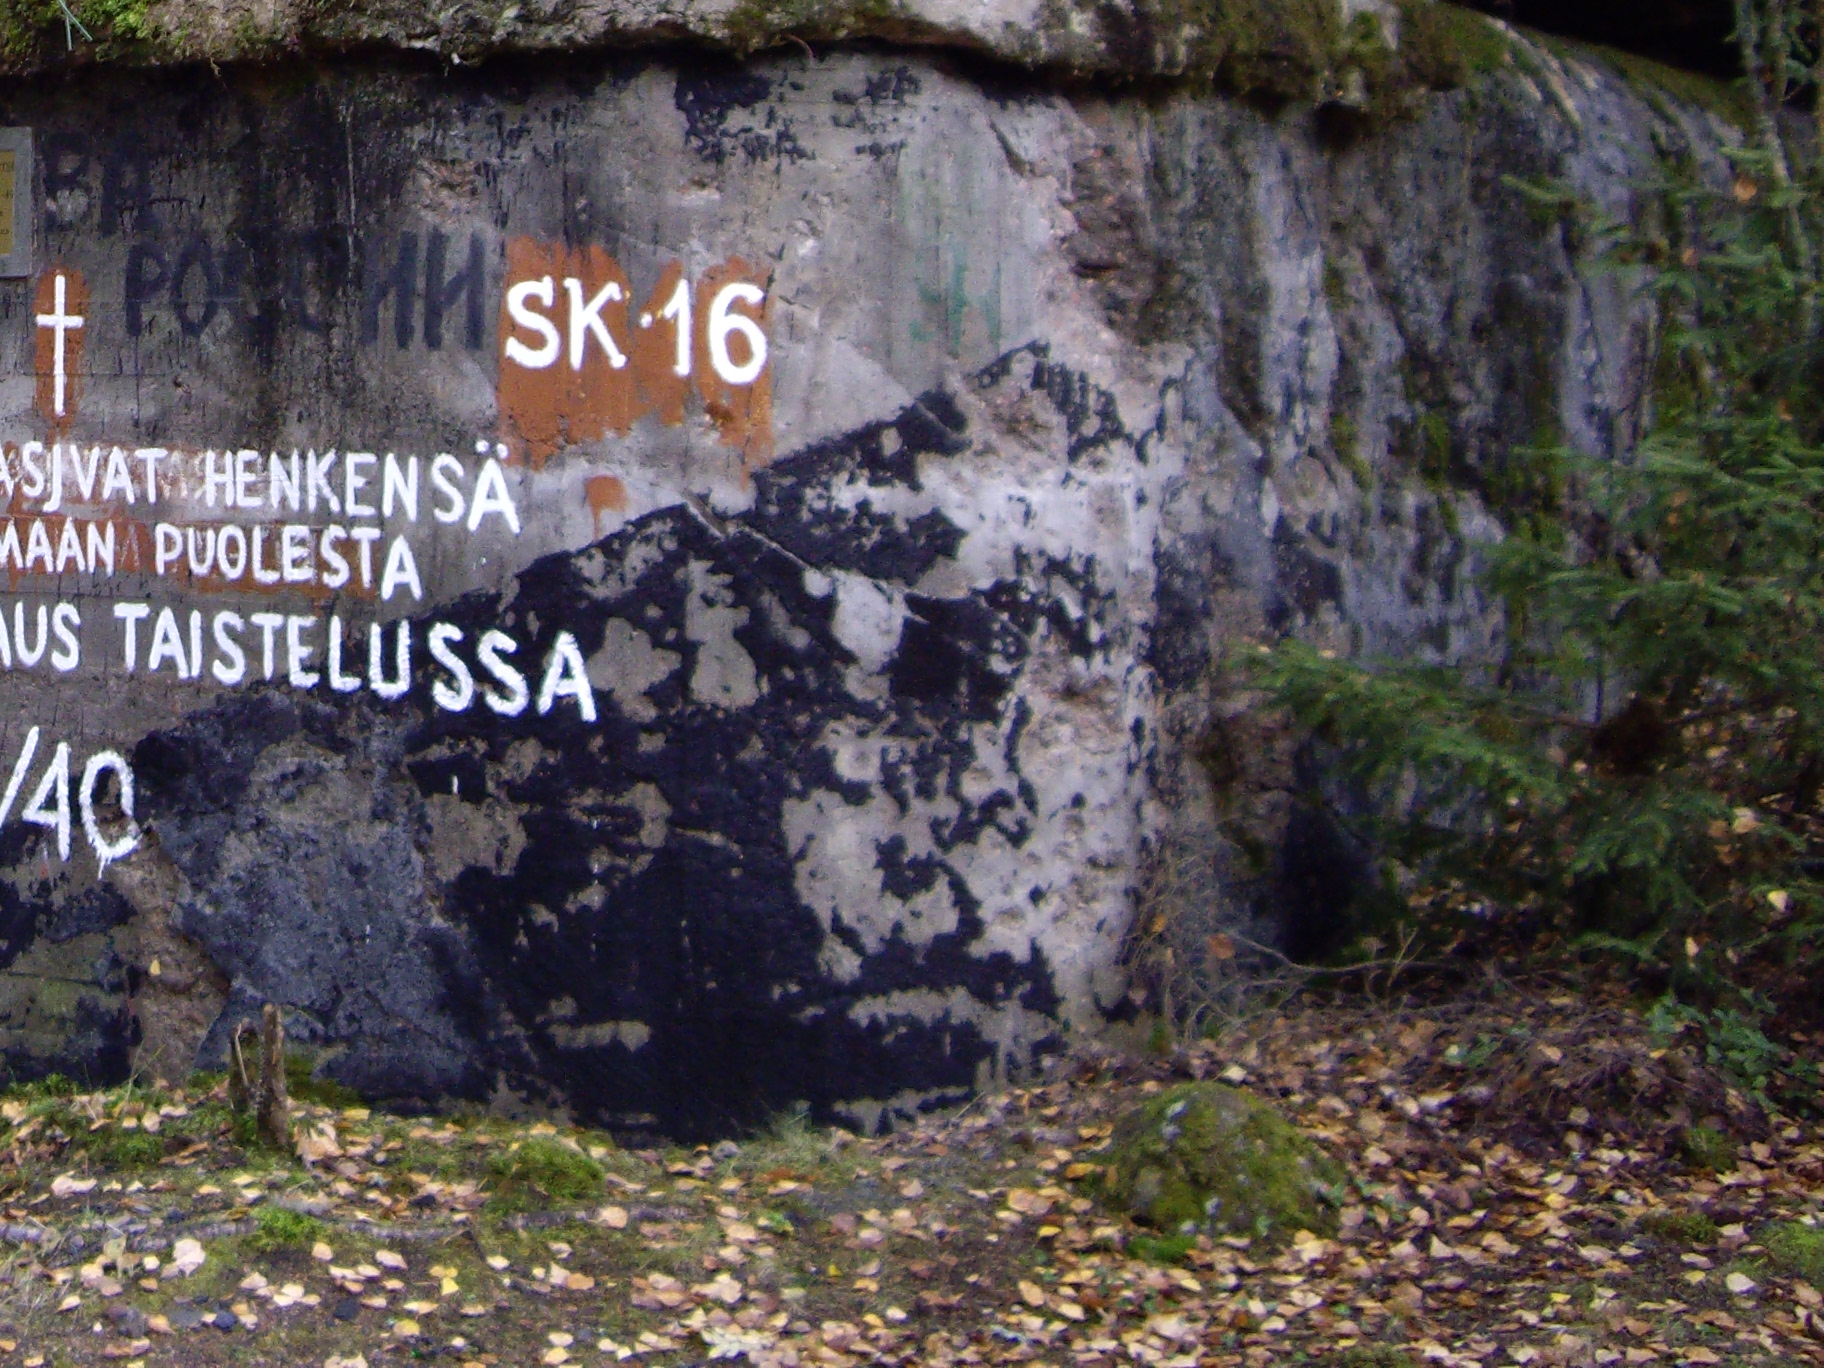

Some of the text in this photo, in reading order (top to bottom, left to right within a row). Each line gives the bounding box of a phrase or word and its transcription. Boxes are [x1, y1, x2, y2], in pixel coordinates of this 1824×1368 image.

[205, 440, 522, 534] HENKENSÄ
[155, 522, 423, 602] PUOLESTA
[114, 603, 597, 722] TAISTELUSSA
